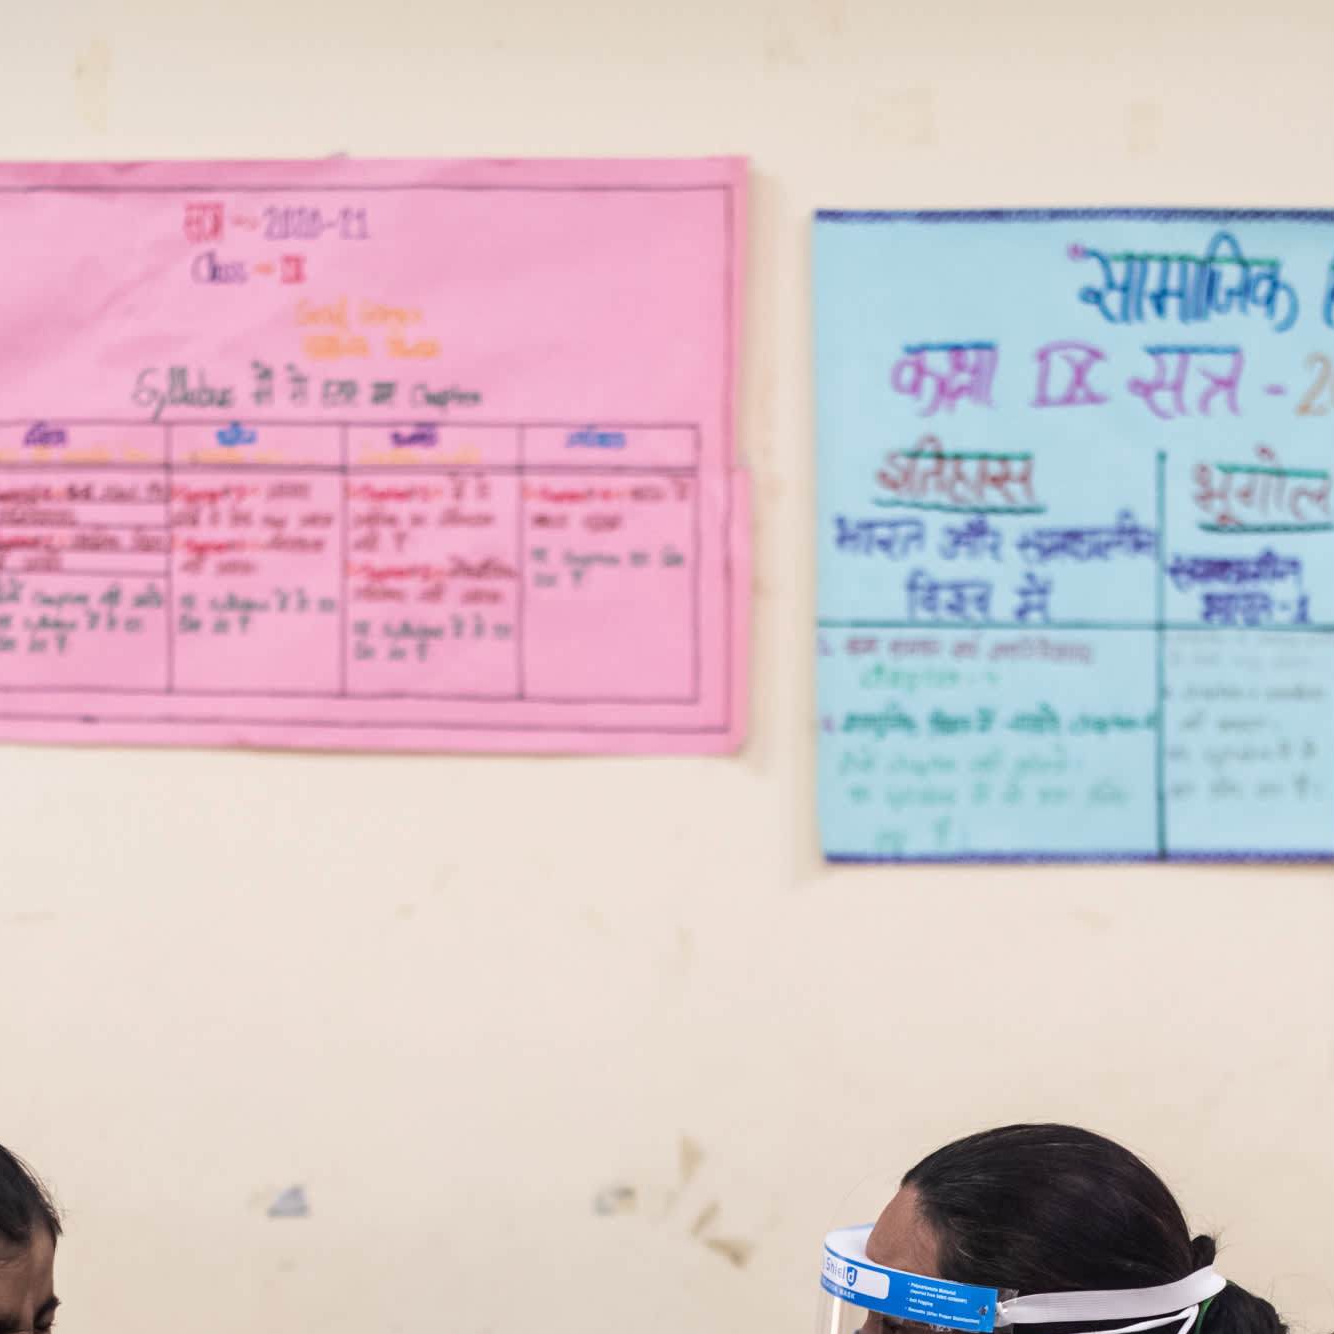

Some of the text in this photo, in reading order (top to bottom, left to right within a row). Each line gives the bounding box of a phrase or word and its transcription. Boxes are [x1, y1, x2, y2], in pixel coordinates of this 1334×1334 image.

[1078, 231, 1299, 333] सामाजिक
[891, 341, 1000, 418] कक्षा
[1030, 341, 1109, 408] IX
[1128, 343, 1246, 420] सत्र
[875, 435, 1035, 506] इतिहास
[1193, 443, 1332, 526] भूगोल
